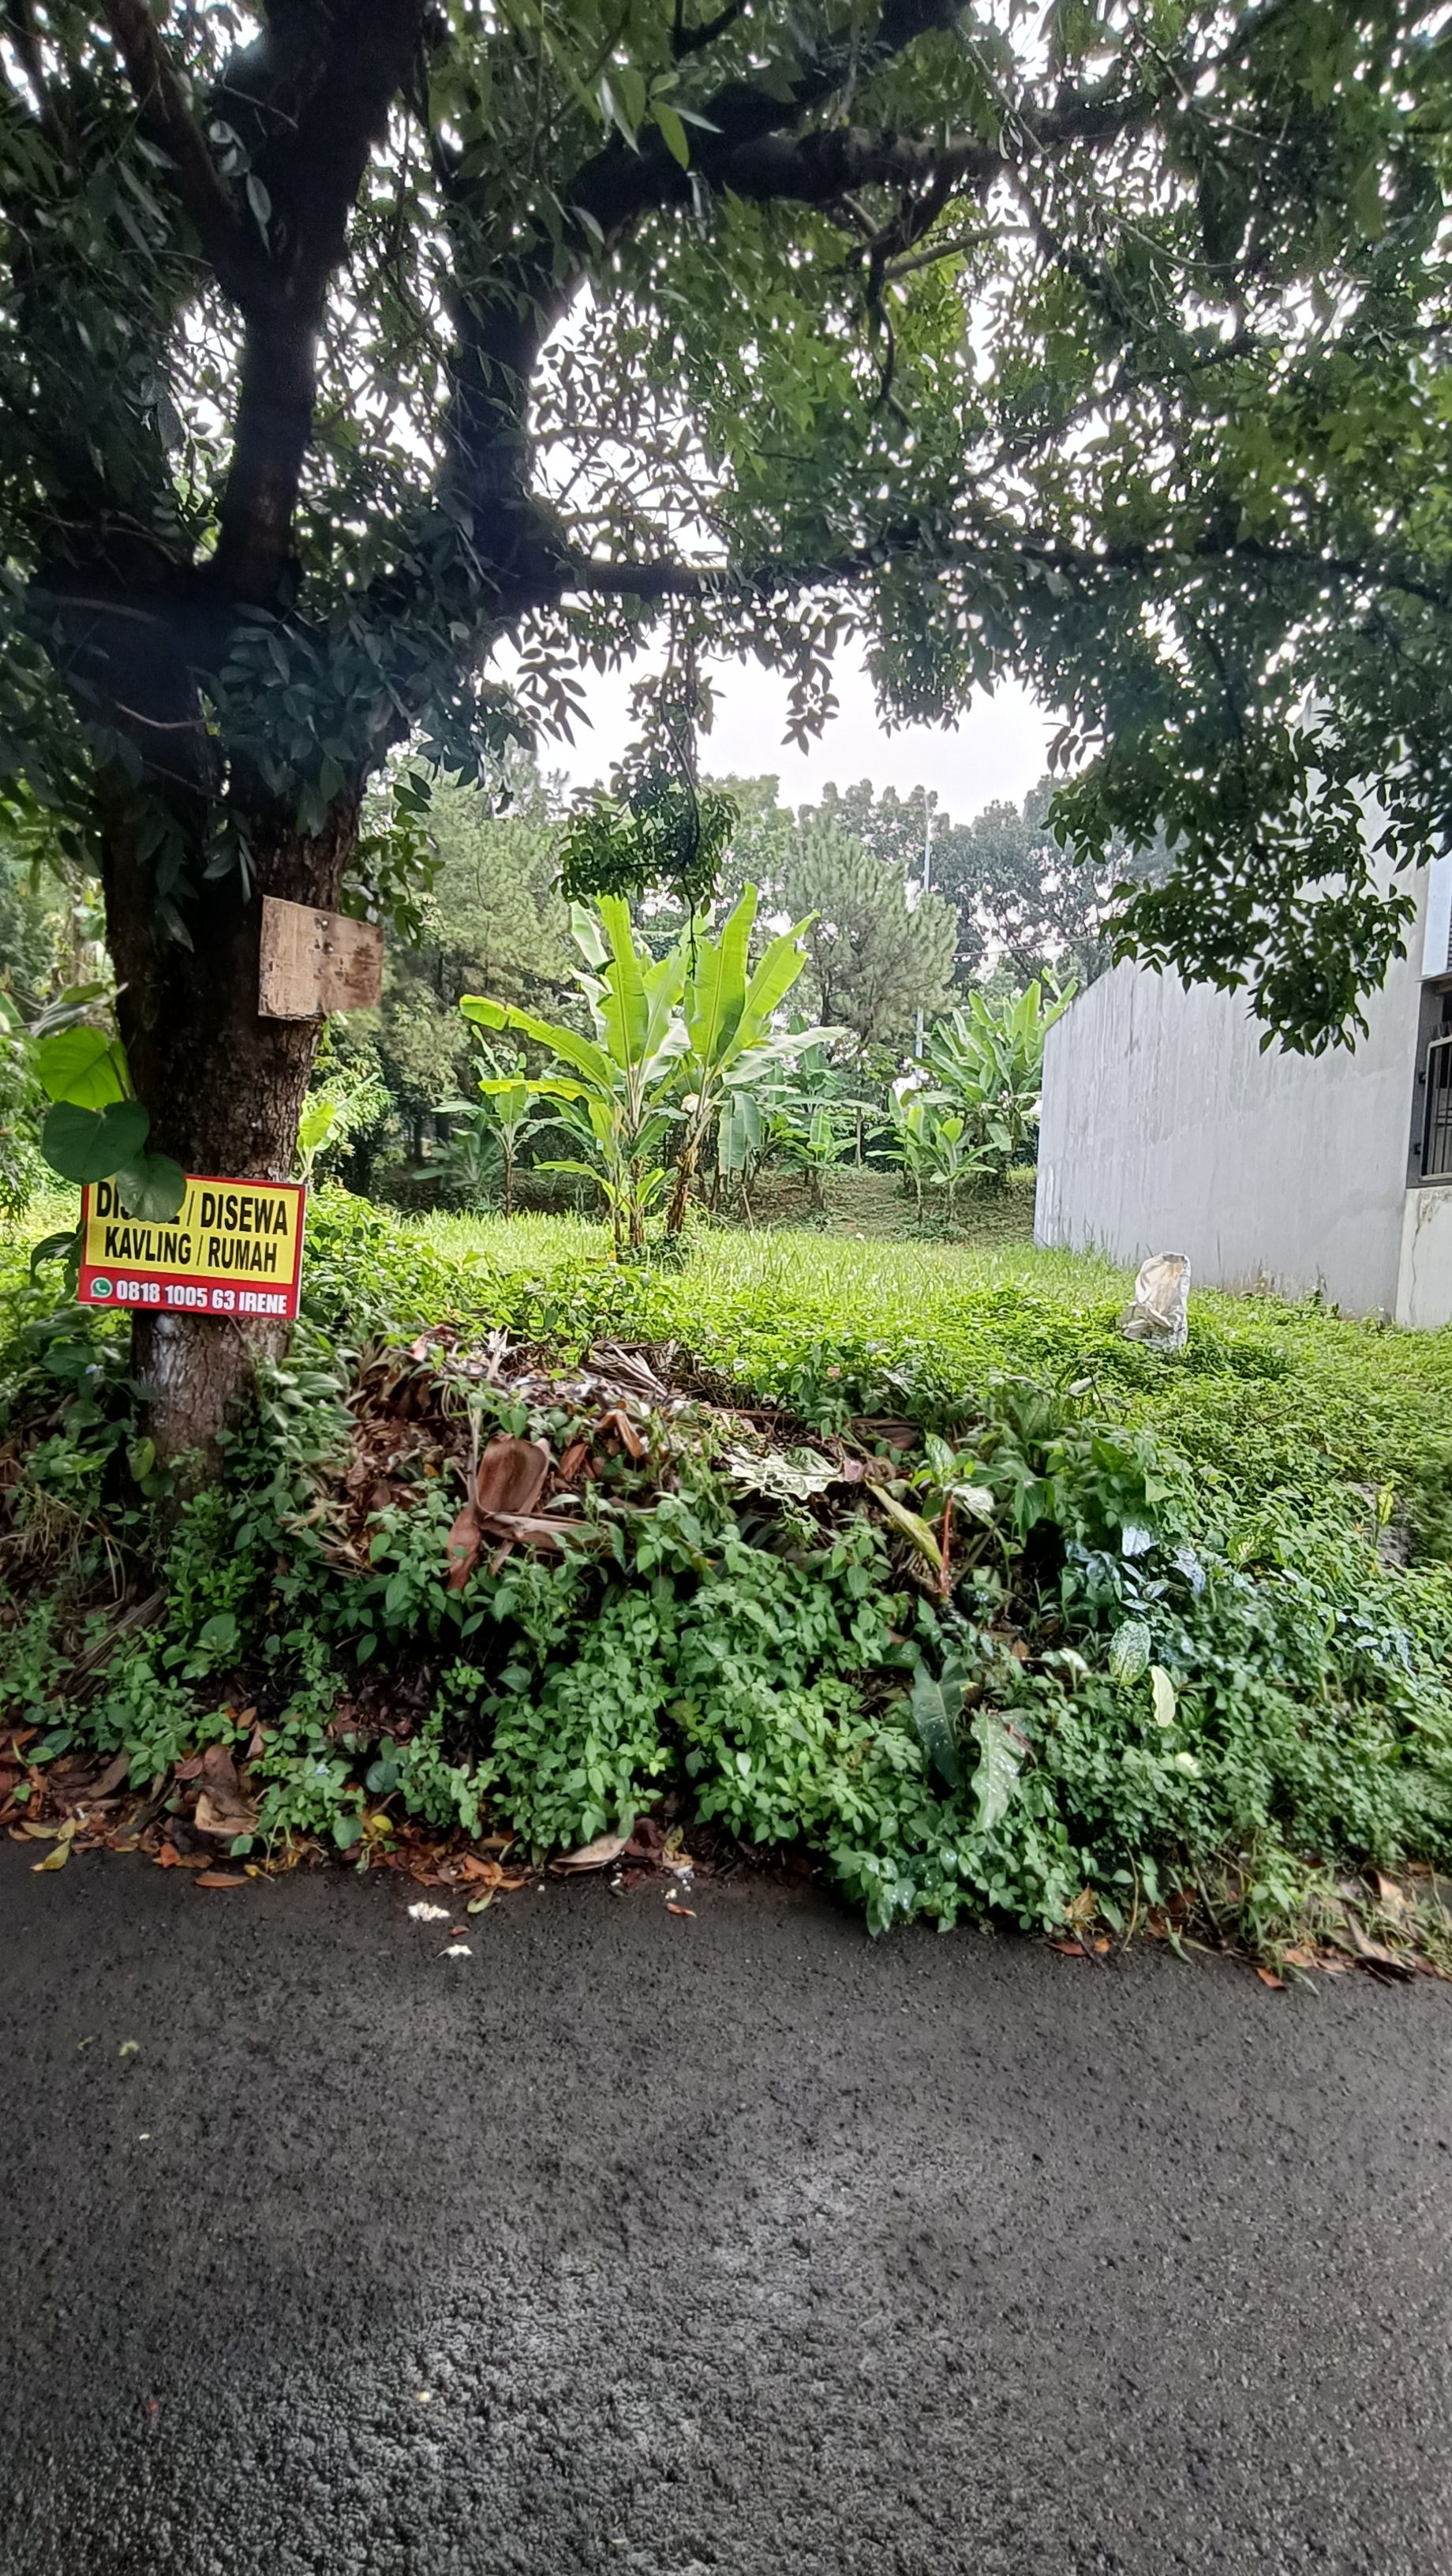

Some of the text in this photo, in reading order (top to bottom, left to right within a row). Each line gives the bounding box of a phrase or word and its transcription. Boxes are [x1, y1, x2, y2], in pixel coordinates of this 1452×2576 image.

[200, 1192, 289, 1236] DISEWA
[104, 1226, 192, 1264] KAVLING
[208, 1236, 278, 1273] RUMAH
[116, 1280, 287, 1314] 0818 1005 63 IRENE
